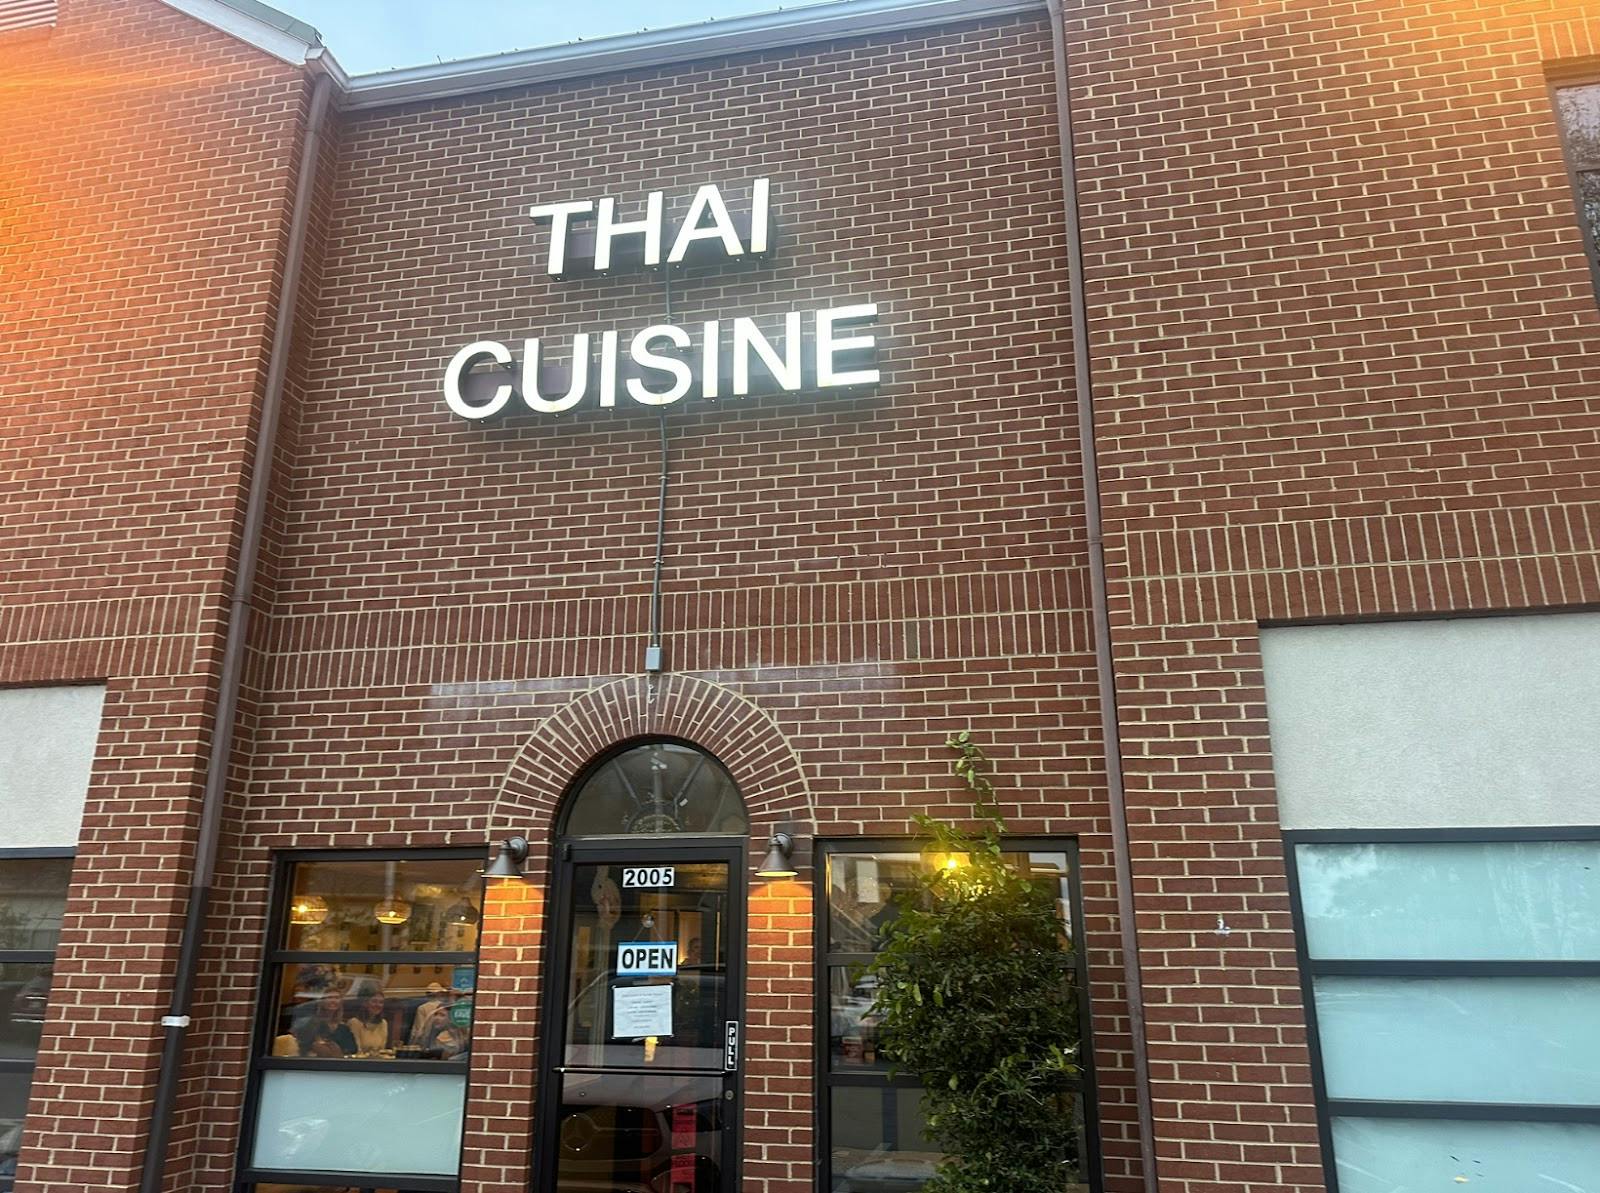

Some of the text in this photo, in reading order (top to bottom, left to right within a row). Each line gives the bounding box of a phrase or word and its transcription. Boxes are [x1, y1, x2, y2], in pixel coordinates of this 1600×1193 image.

[529, 177, 769, 275] THAI
[444, 303, 880, 419] CUISINE
[624, 868, 673, 886] 2005
[621, 948, 674, 969] OPEN
[727, 1027, 736, 1065] PULL
